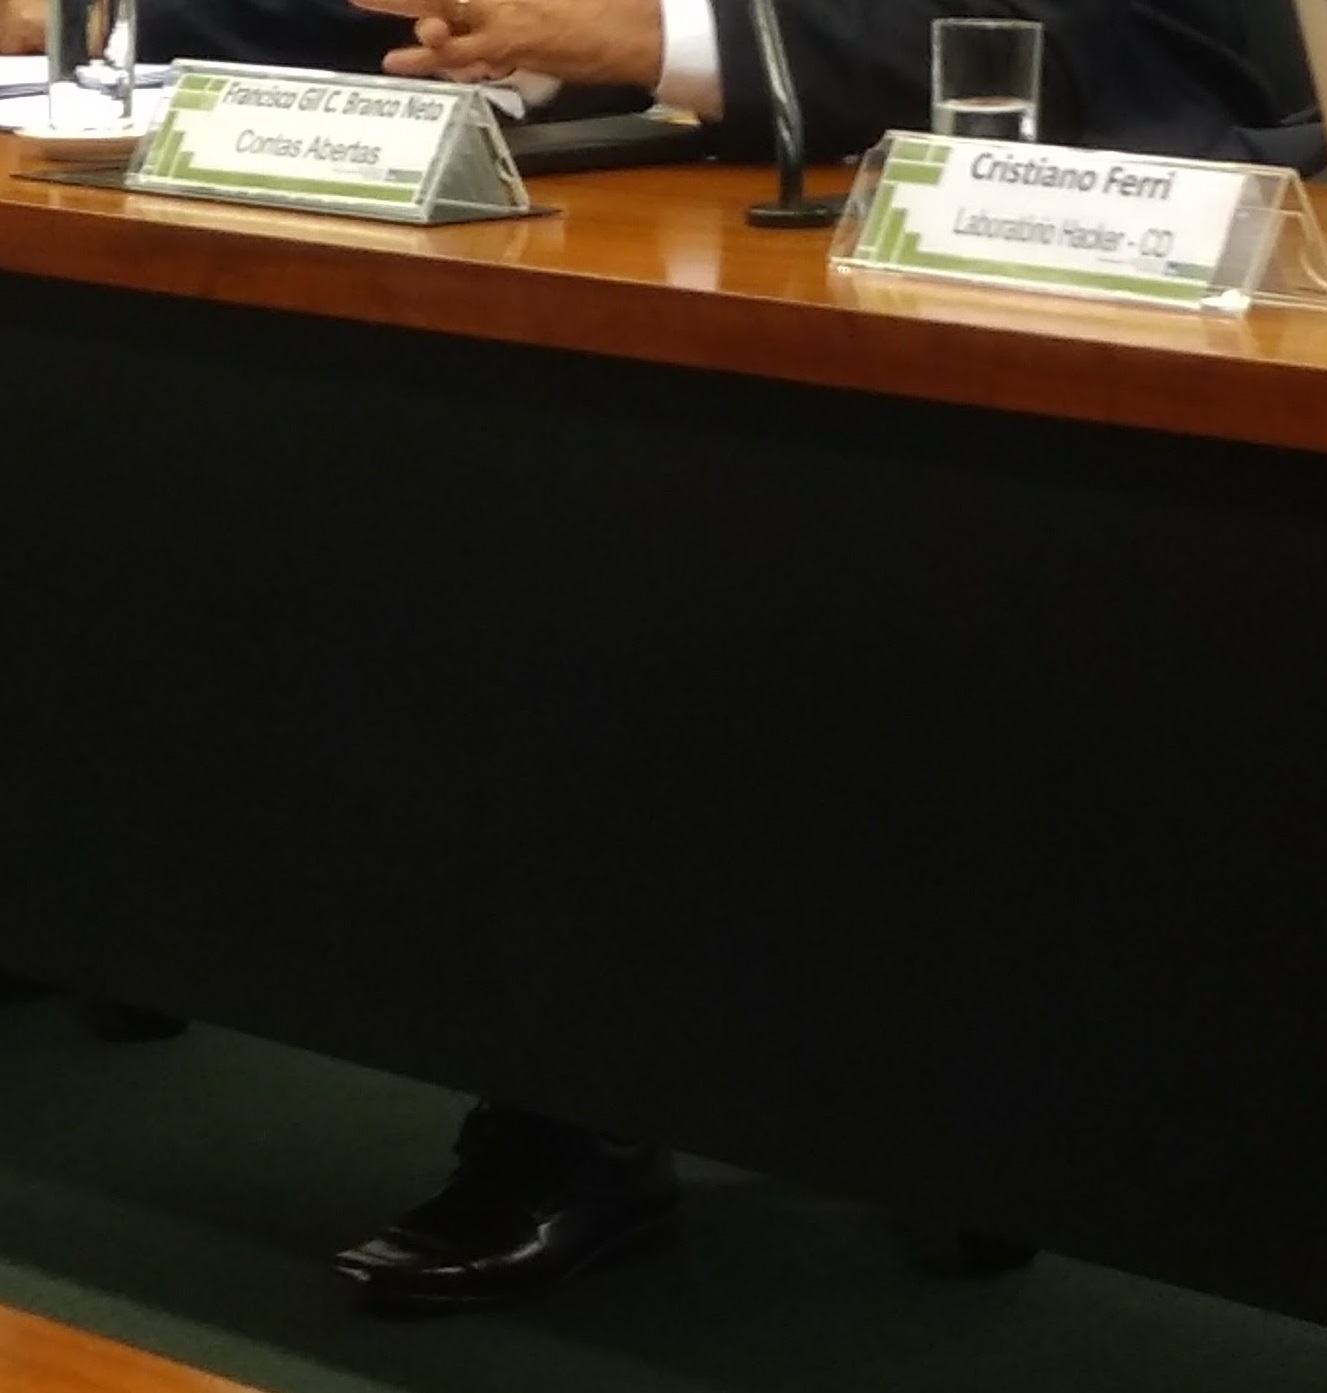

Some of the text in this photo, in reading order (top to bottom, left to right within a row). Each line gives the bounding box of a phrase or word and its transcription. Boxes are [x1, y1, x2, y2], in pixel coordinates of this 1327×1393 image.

[223, 80, 296, 110] Francisco
[298, 86, 326, 113] Gil
[342, 91, 401, 118] Branco
[402, 94, 444, 122] Neto
[235, 128, 382, 165] Contas Abertas
[970, 150, 1176, 201] Cristiano Ferri
